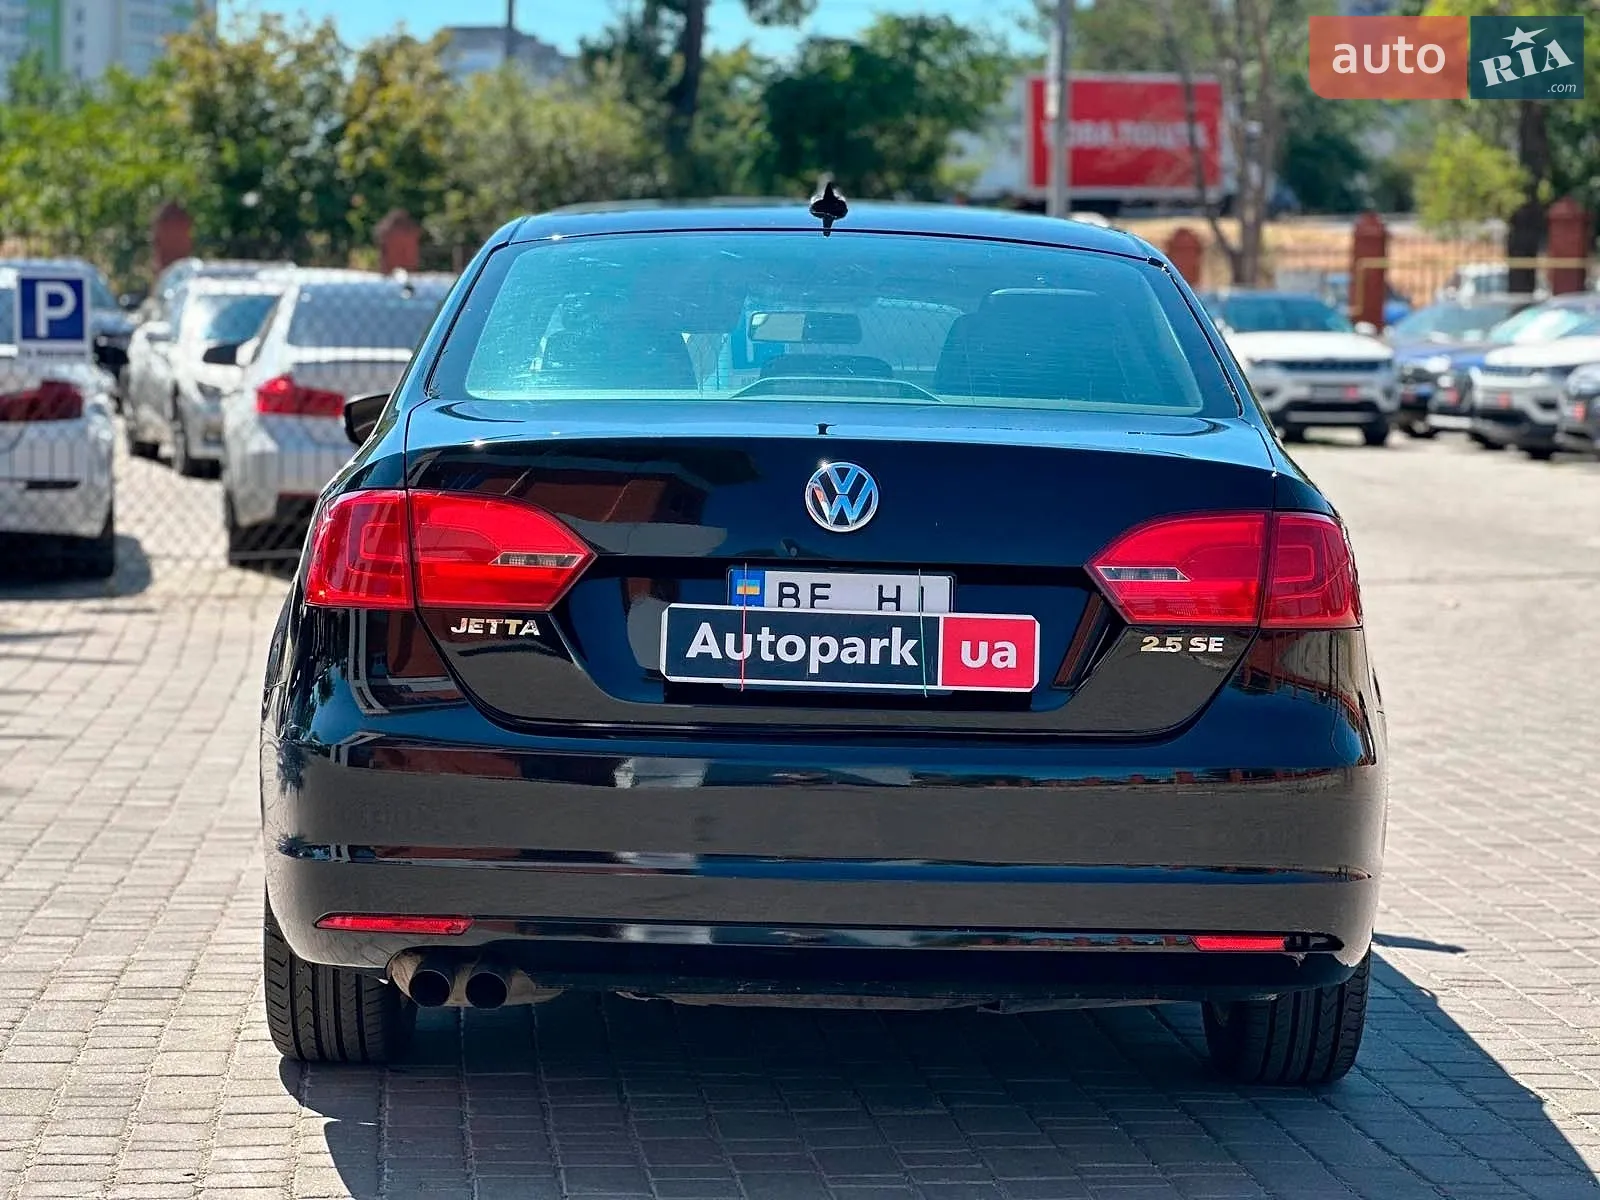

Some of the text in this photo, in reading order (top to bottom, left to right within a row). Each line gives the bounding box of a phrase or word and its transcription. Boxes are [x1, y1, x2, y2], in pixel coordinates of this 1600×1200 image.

[35, 280, 77, 339] P
[805, 461, 879, 533] VW
[449, 617, 541, 636] JETTA
[685, 621, 1017, 674] Autopark ua
[1188, 635, 1225, 653] SE
